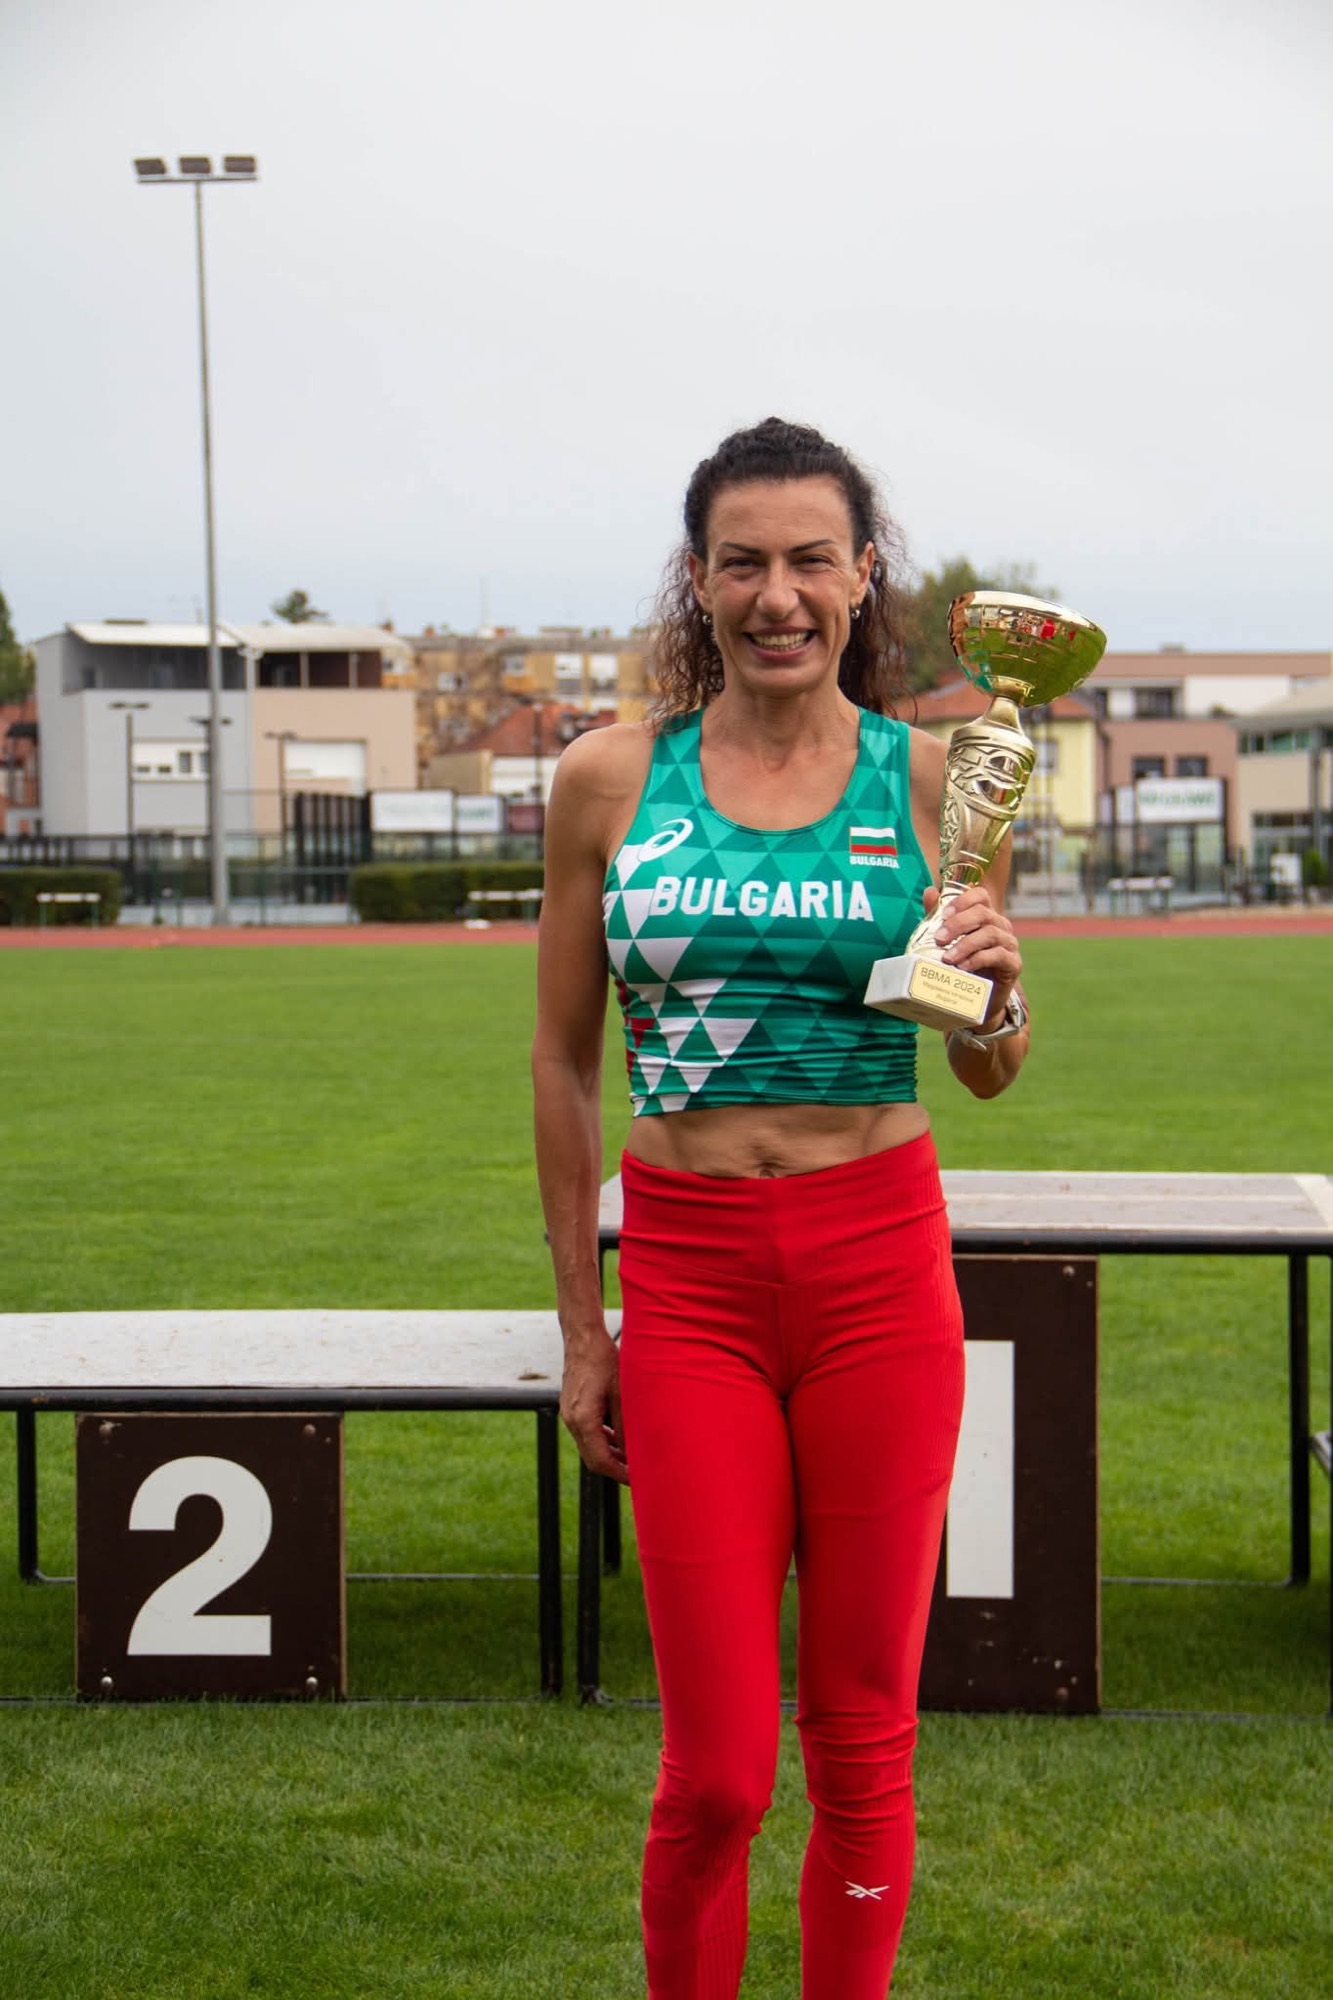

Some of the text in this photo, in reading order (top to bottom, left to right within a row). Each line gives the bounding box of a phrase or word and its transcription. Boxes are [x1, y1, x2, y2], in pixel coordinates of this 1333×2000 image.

[850, 855, 900, 869] BULGARIA
[649, 876, 873, 921] BULGARIA
[921, 967, 950, 984] BBMA
[954, 979, 981, 995] 2024
[127, 1455, 273, 1656] 2
